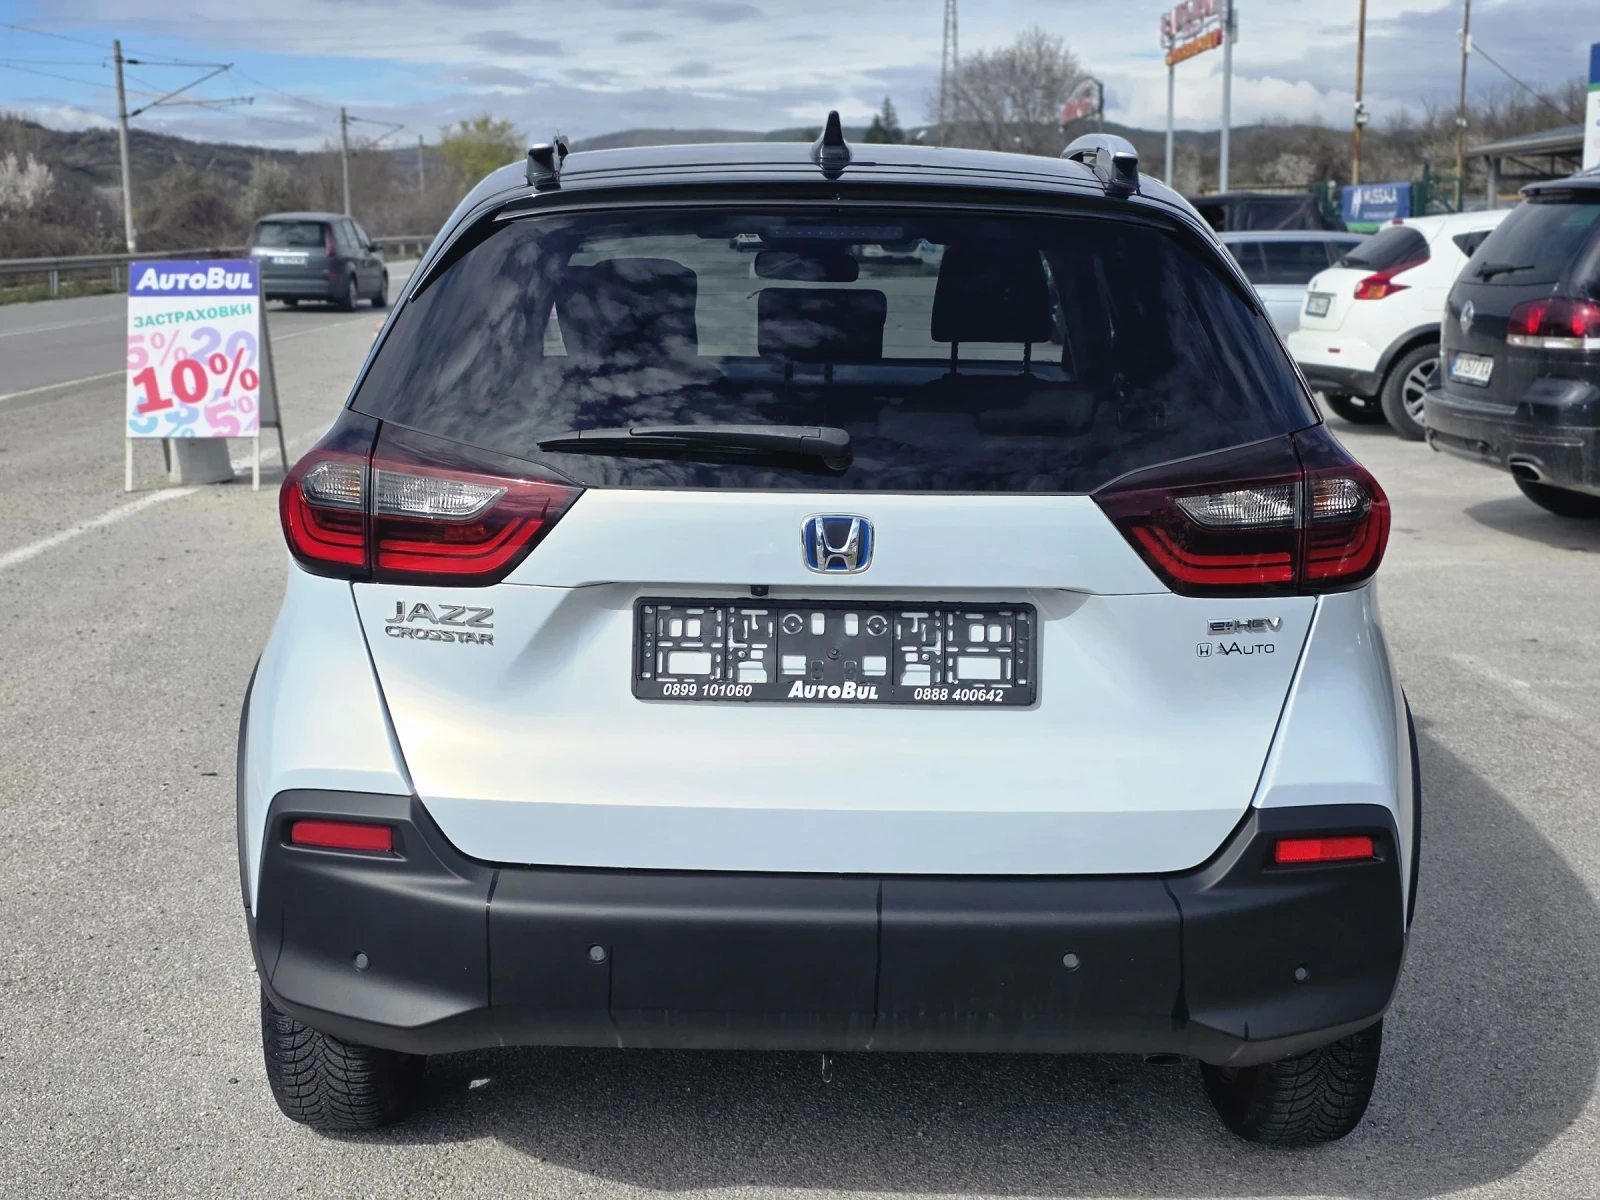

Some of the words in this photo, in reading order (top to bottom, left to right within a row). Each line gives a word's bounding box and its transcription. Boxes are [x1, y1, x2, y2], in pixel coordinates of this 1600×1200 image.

[133, 303, 253, 329] ЗАСТРАХОВКИ
[132, 347, 259, 415] 10%
[385, 600, 494, 628] JAZZ
[385, 625, 494, 646] CROSSTAR
[663, 683, 697, 696] 0899
[702, 683, 753, 697] 101060
[914, 687, 949, 701] 0888
[952, 688, 1004, 702] 400642
